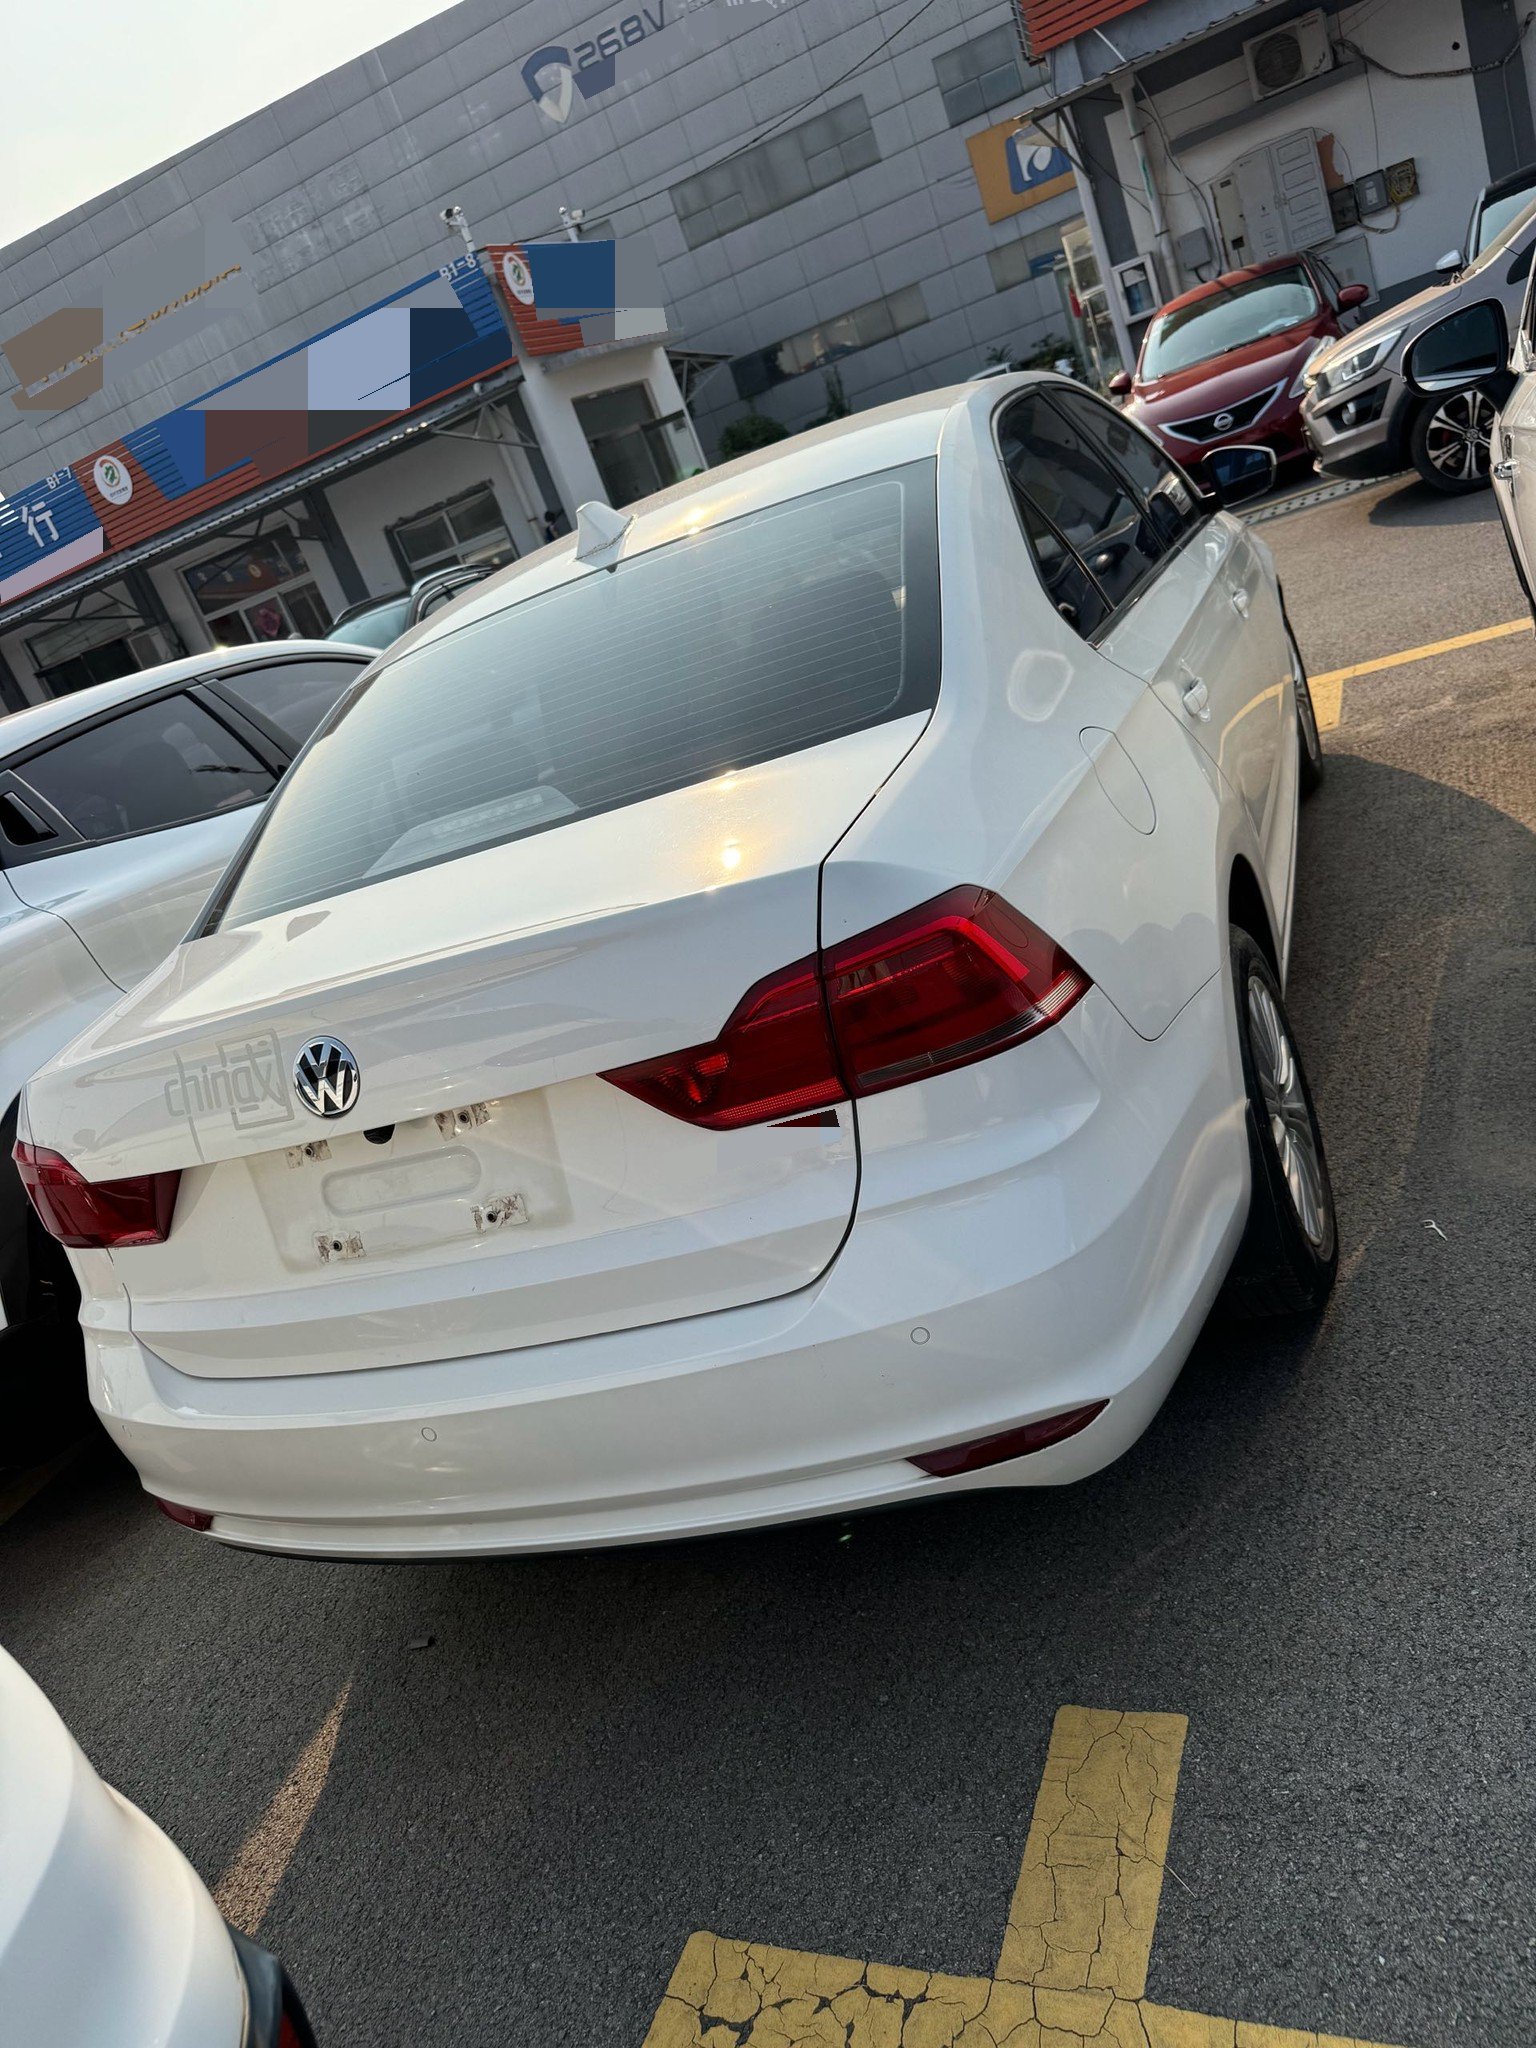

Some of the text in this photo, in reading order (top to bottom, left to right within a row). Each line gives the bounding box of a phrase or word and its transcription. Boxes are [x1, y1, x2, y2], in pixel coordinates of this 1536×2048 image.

[440, 253, 477, 281] B1-8
[46, 466, 72, 490] B1-7
[21, 501, 60, 548] 行
